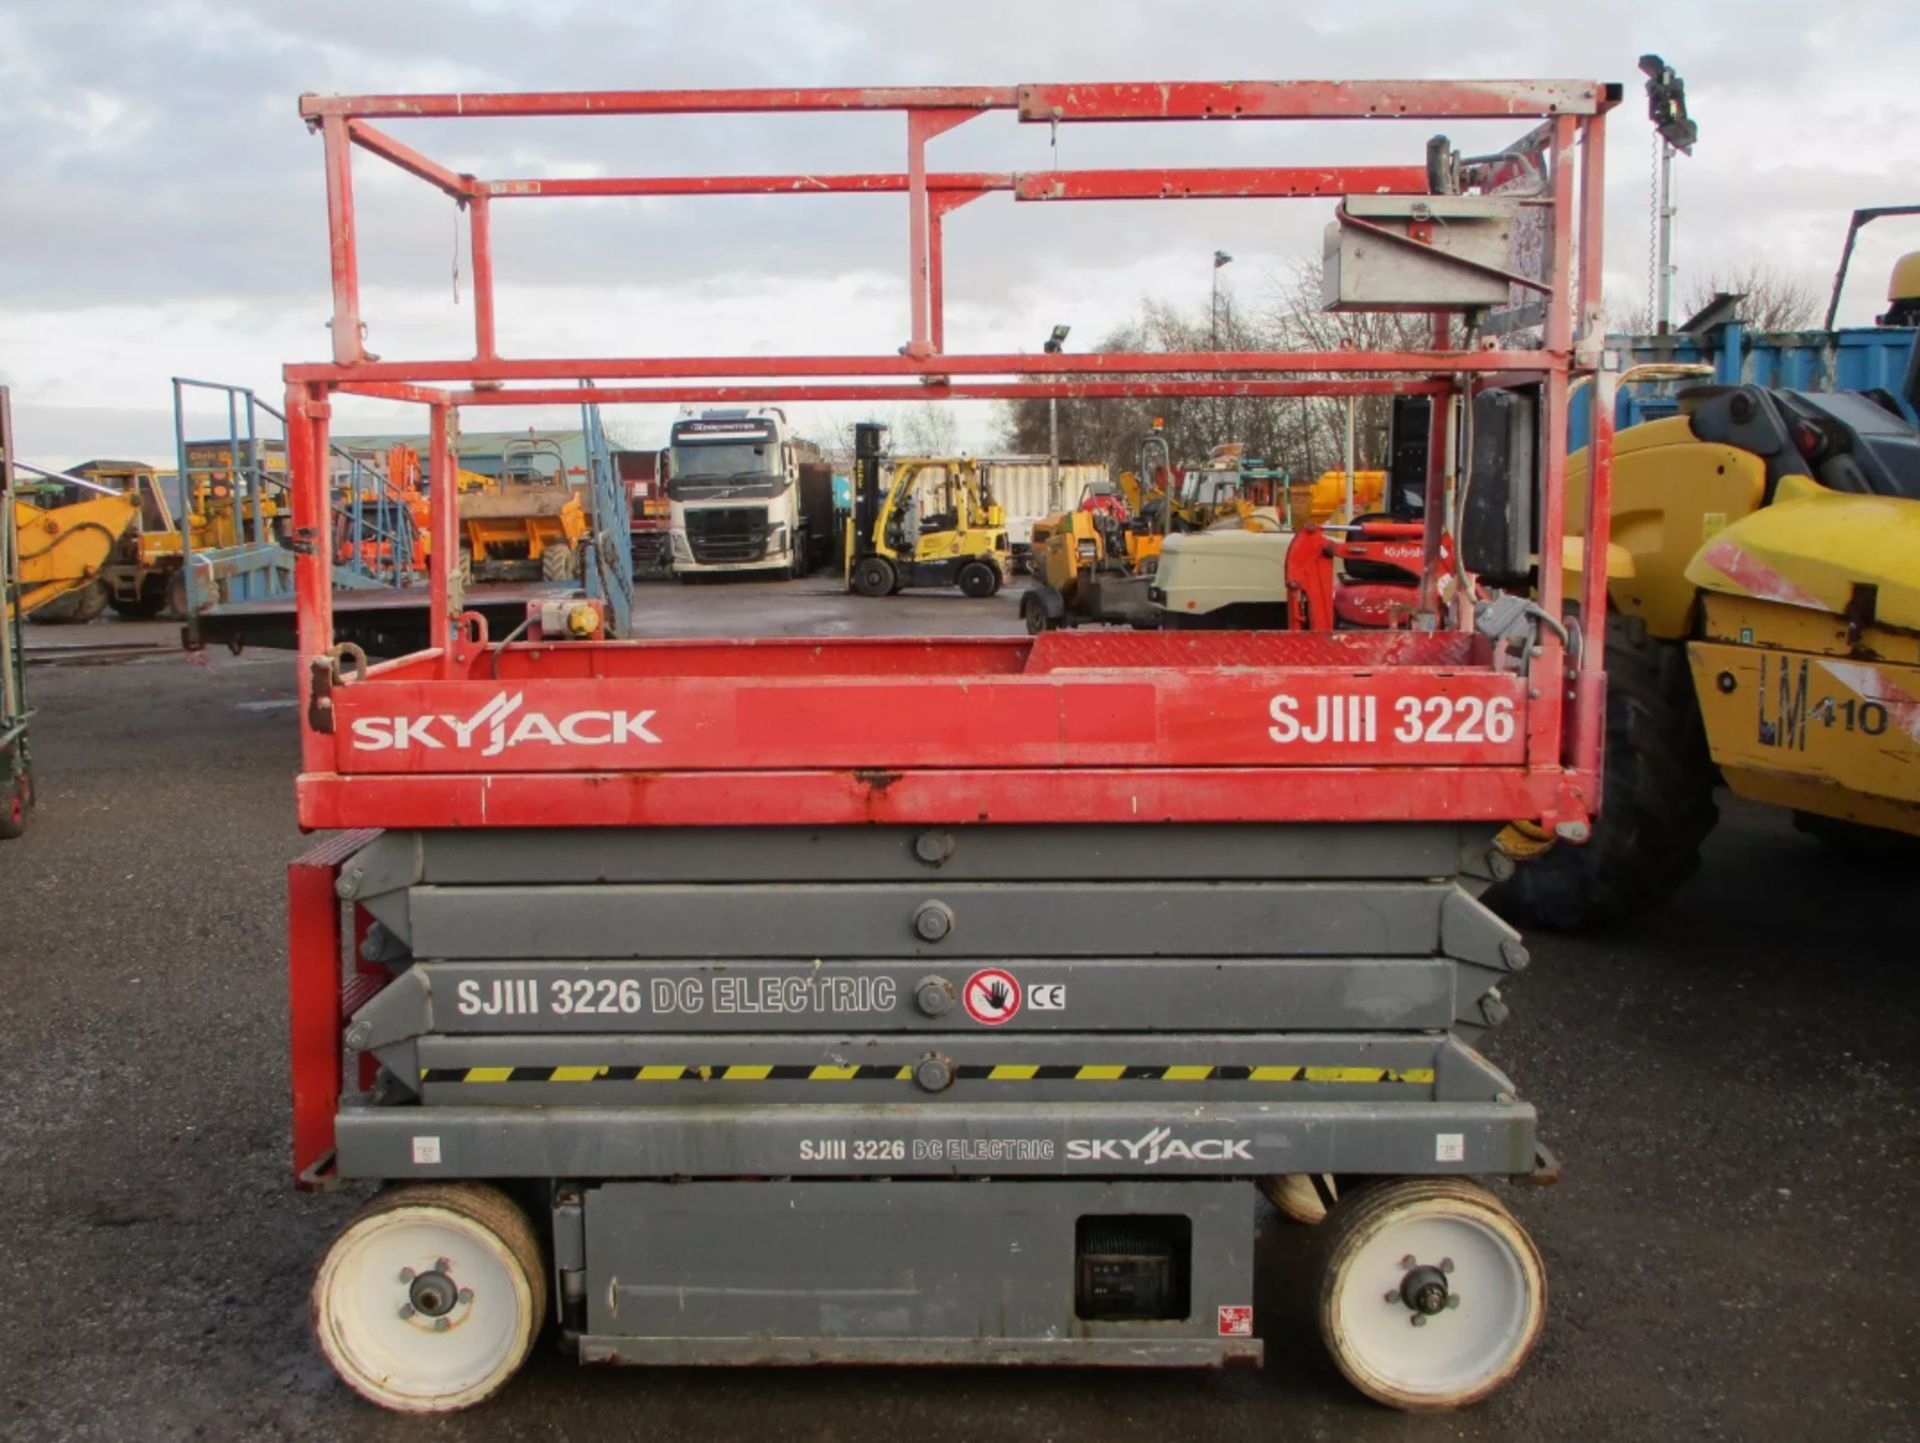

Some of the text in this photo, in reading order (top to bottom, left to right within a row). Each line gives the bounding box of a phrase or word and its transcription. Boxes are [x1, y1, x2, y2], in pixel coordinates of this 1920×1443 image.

[352, 690, 662, 757] SKYJACK
[1268, 694, 1515, 743] SJIII 3226
[458, 976, 897, 1015] SJIII 3226 DC ELECTRIC
[1031, 986, 1063, 1007] CE
[799, 1139, 1055, 1160] SJIII 3226 DC ELECTRIC
[1066, 1126, 1254, 1166] SKYJACK
